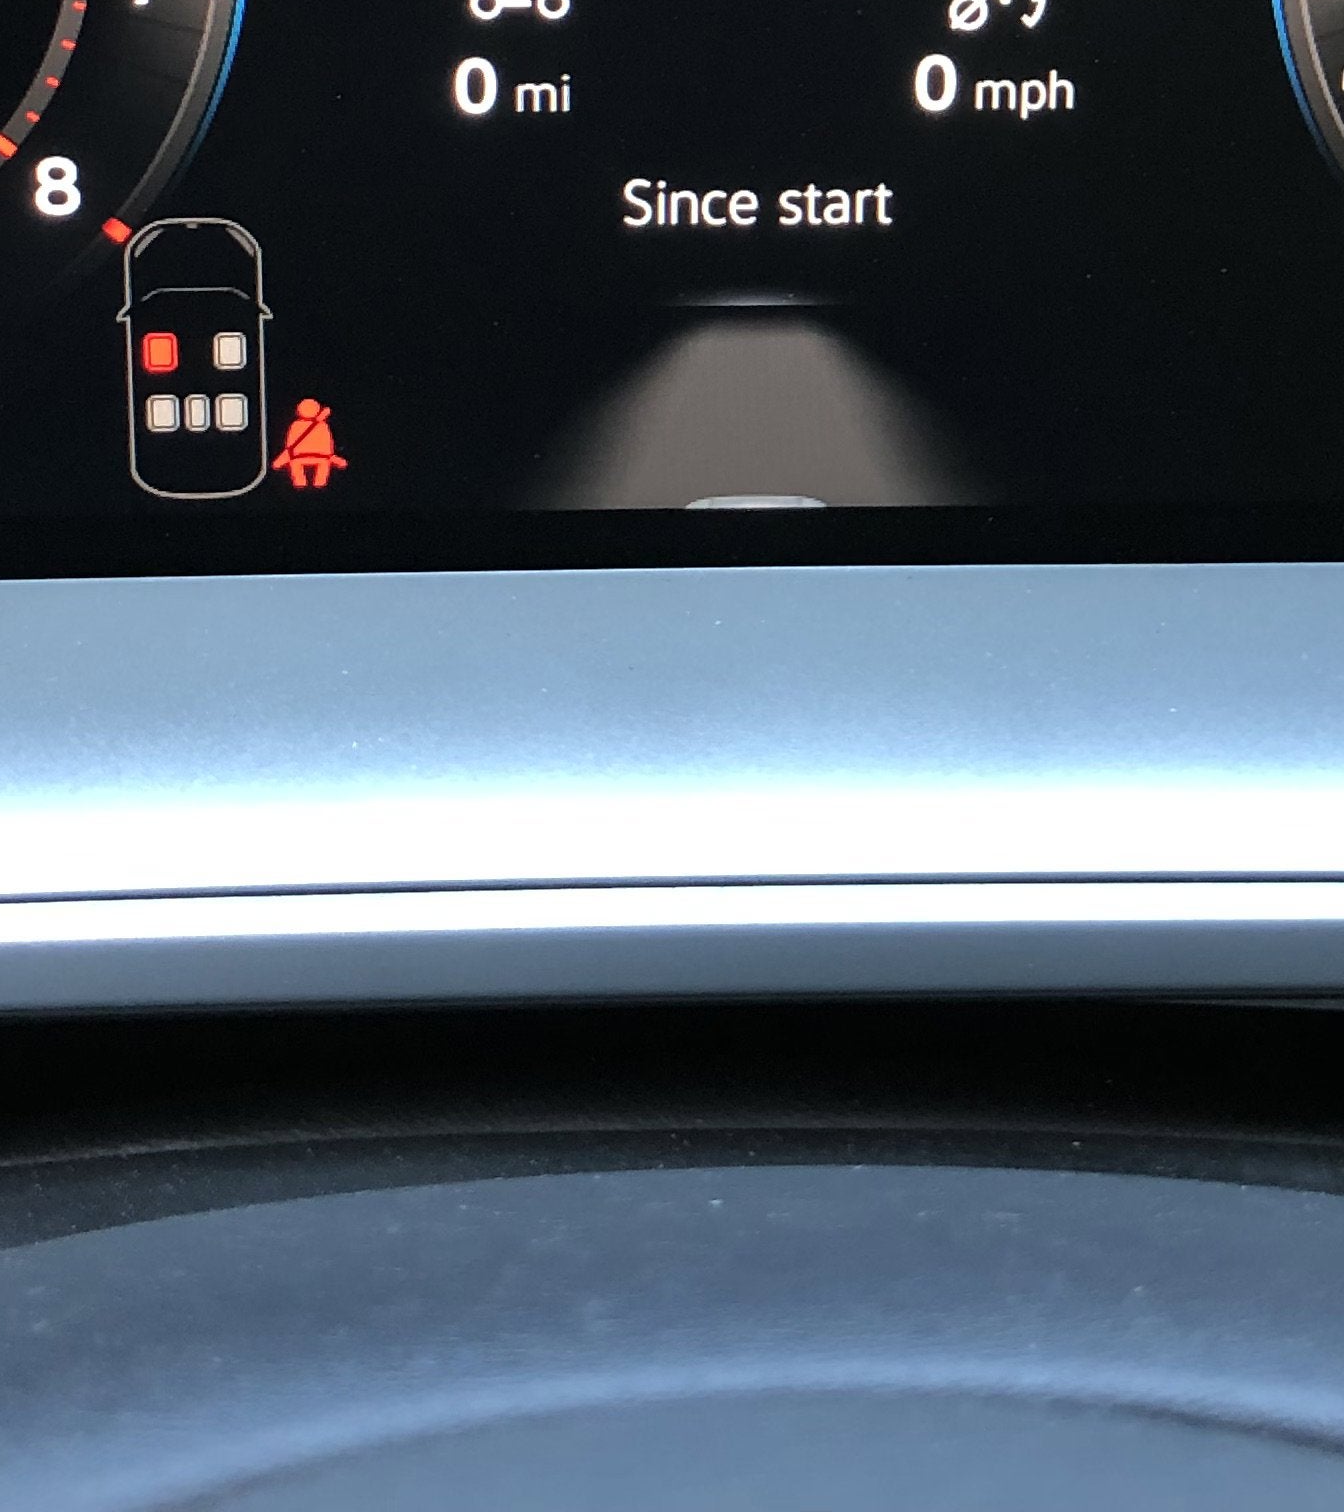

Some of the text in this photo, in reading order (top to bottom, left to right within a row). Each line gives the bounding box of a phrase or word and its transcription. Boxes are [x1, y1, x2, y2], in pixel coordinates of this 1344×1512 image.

[453, 57, 571, 115] 0 mi
[914, 54, 1075, 119] 0 mph
[34, 155, 82, 217] 8
[623, 179, 894, 227] Since start
